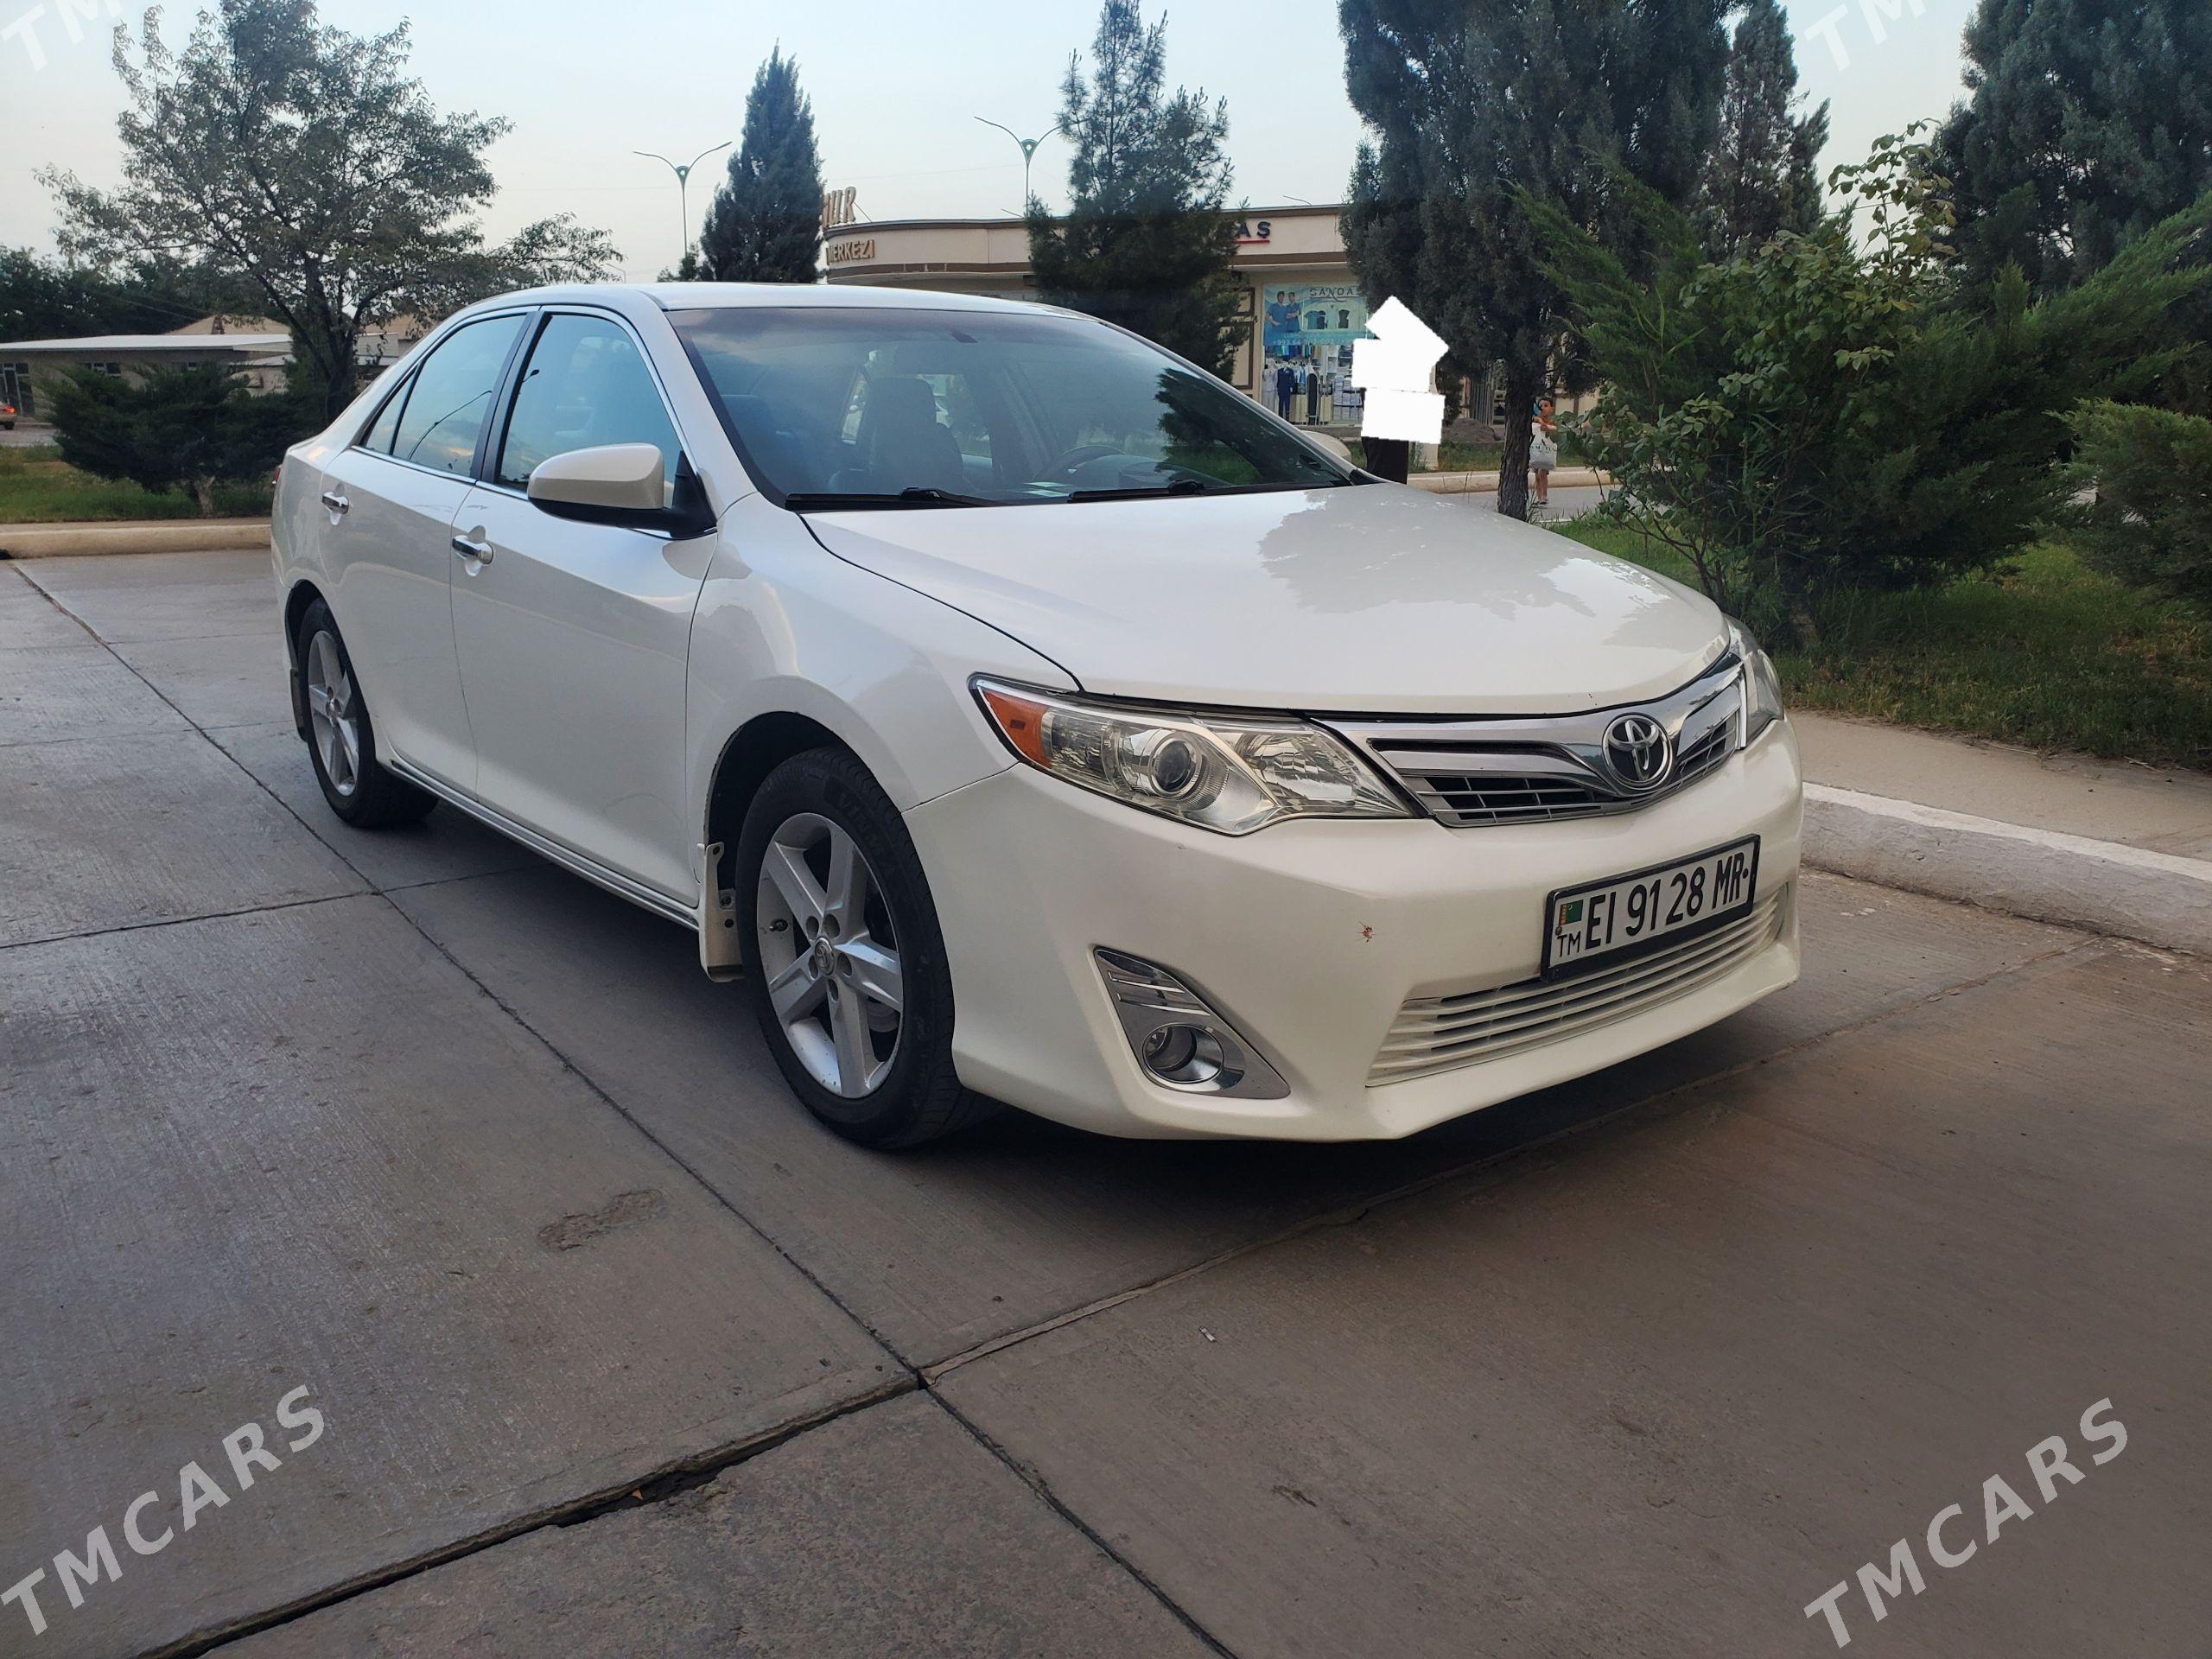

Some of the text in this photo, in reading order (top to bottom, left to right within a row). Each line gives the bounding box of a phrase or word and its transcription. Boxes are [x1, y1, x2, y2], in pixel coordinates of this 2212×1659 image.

[1586, 892, 1617, 950] EI
[1712, 852, 1745, 909] MR
[1557, 931, 1581, 957] TM
